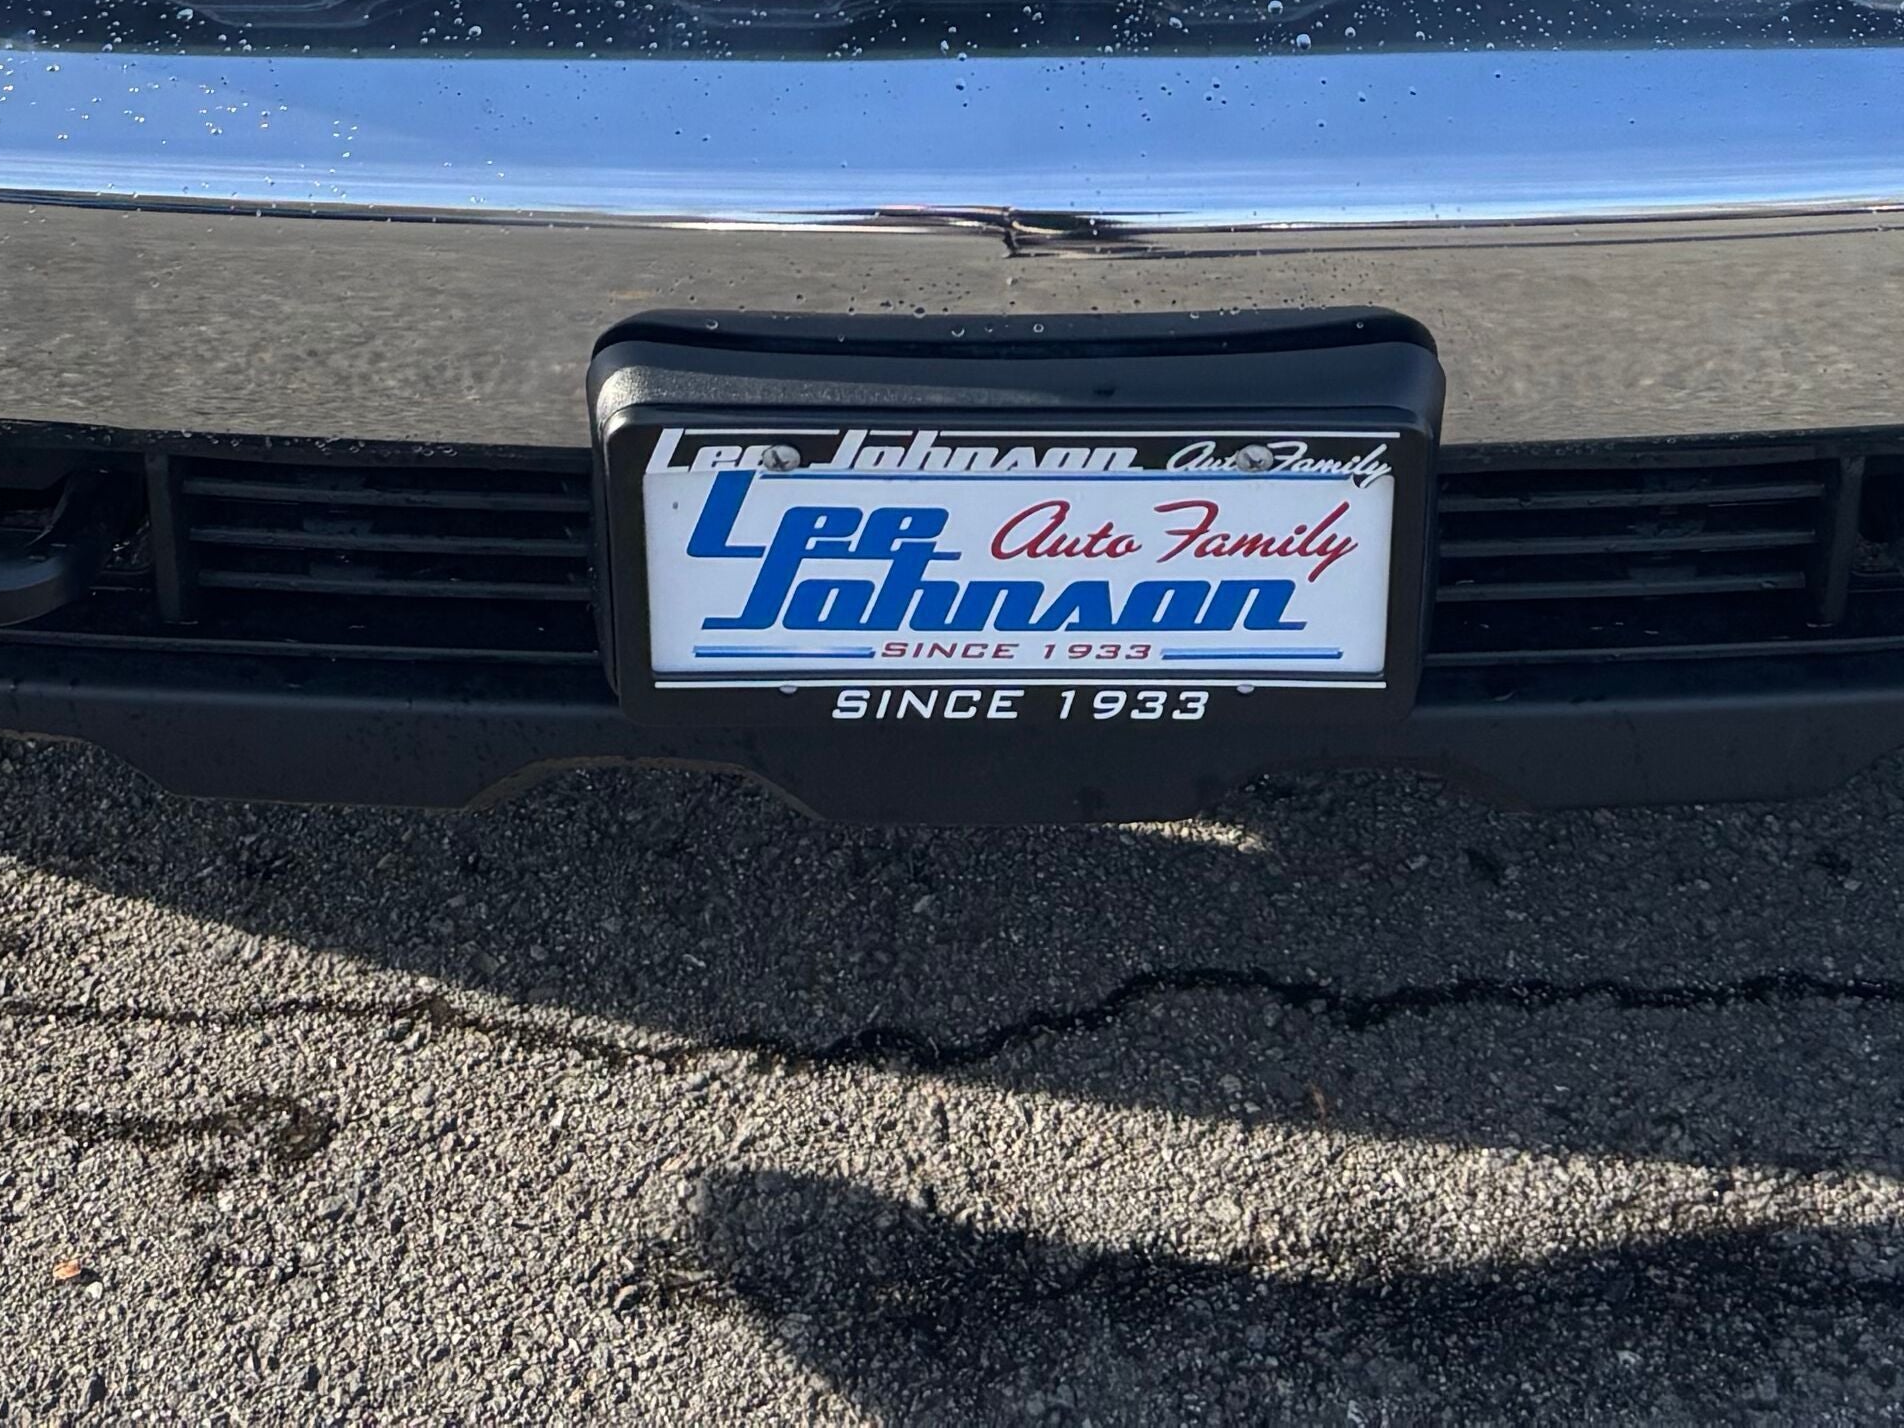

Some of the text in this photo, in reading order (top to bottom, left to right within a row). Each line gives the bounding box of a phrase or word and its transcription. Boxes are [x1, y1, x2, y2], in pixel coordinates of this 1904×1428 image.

[809, 429, 1143, 472] Johnson
[1166, 440, 1262, 472] Aut
[1267, 441, 1391, 489] Family
[686, 470, 962, 560] Lee
[991, 500, 1358, 582] Auto Family
[701, 540, 1307, 632] Johnson
[881, 641, 1151, 660] SINCE 1933
[831, 689, 1210, 721] SINCE 1933
